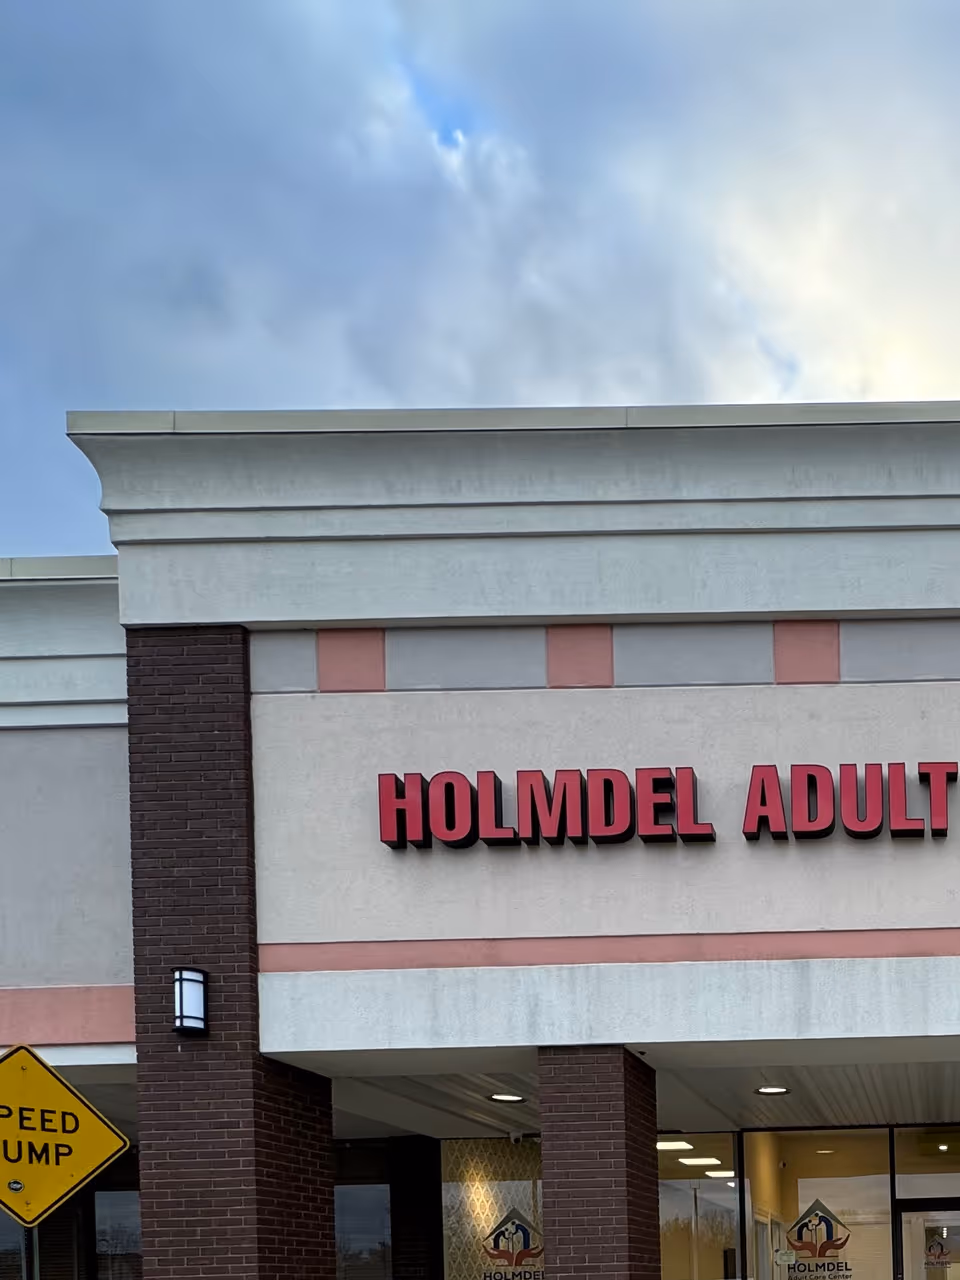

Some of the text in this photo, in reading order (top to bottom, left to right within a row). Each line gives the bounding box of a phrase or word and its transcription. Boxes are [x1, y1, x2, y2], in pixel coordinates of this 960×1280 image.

[377, 767, 716, 850] HOLMDEL
[742, 761, 959, 840] ADULT
[787, 1261, 852, 1273] HOLMDEL
